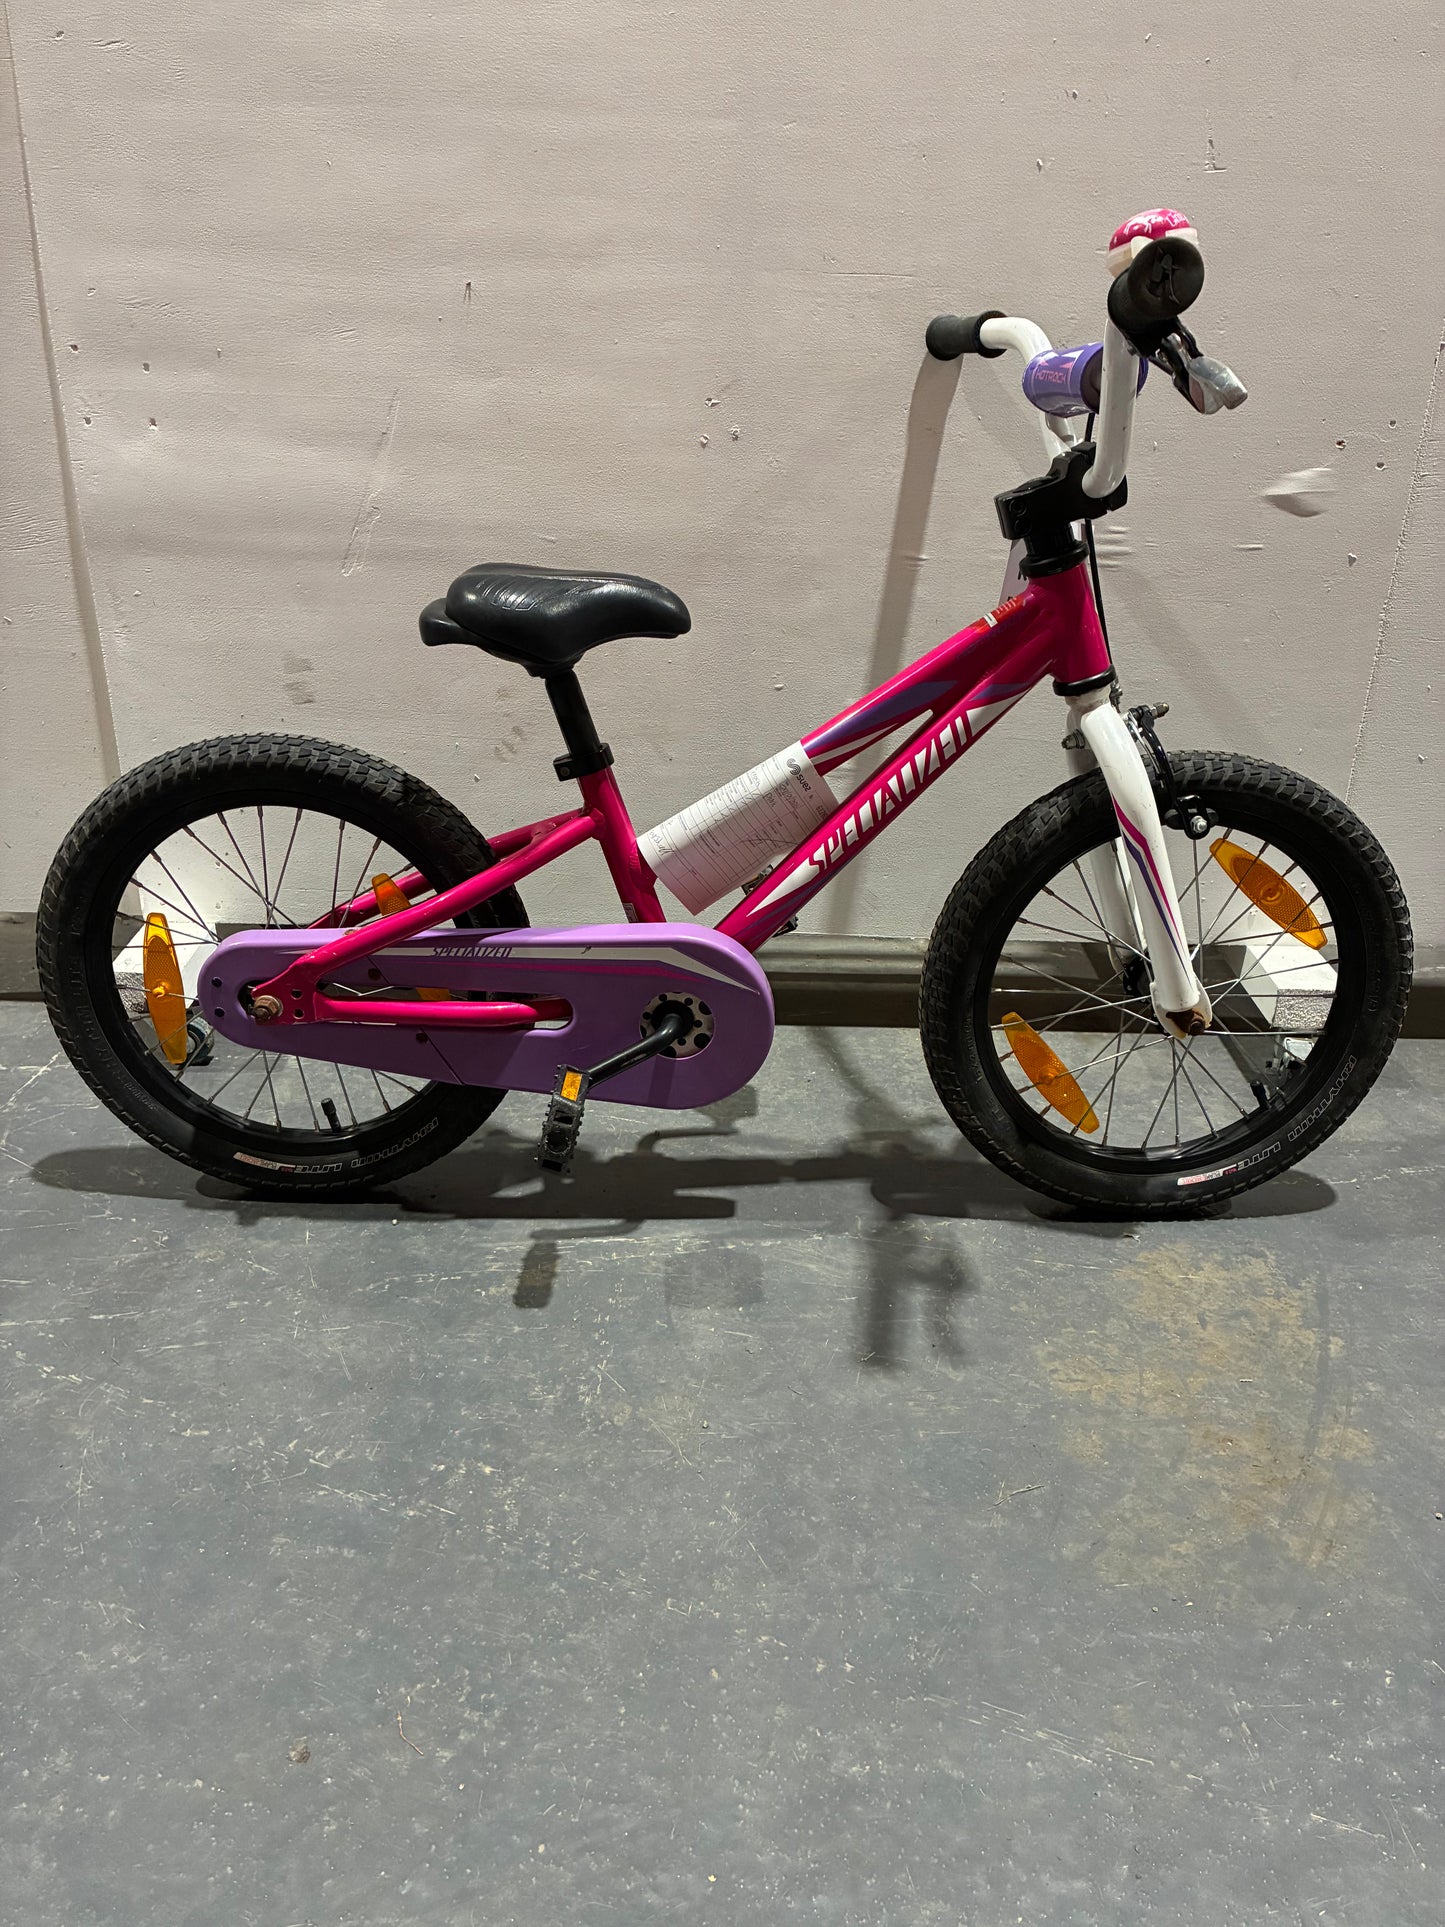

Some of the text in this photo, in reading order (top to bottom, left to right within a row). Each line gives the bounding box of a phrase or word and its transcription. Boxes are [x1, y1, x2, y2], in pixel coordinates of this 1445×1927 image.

[796, 773, 812, 793] suez
[808, 710, 974, 872] SPECIALIZED
[431, 947, 513, 958] SPECIALIZED
